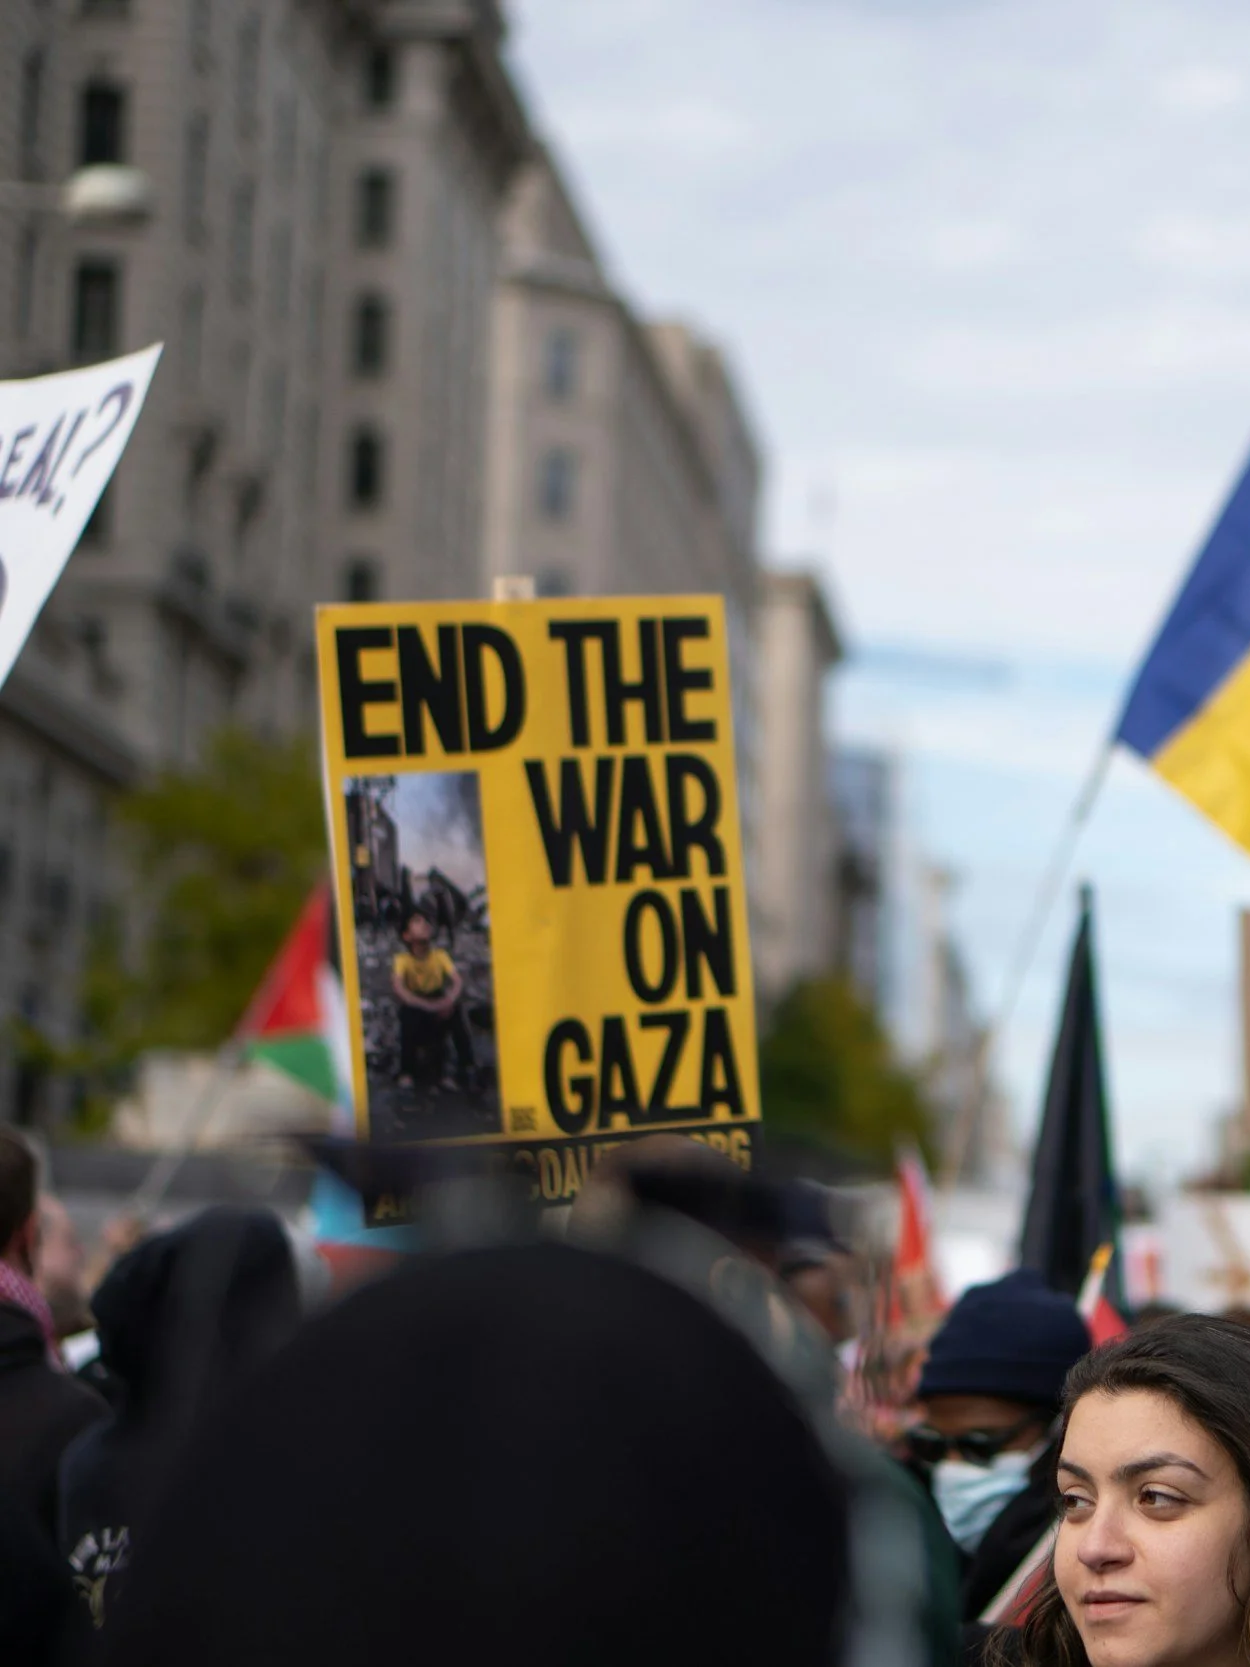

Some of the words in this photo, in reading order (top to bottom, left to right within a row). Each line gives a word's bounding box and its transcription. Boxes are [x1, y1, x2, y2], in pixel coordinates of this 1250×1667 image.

[334, 622, 528, 760] END
[548, 616, 718, 749] THE
[523, 753, 728, 888] WAR
[623, 885, 737, 1005] ON
[543, 1007, 746, 1136] GAZA
